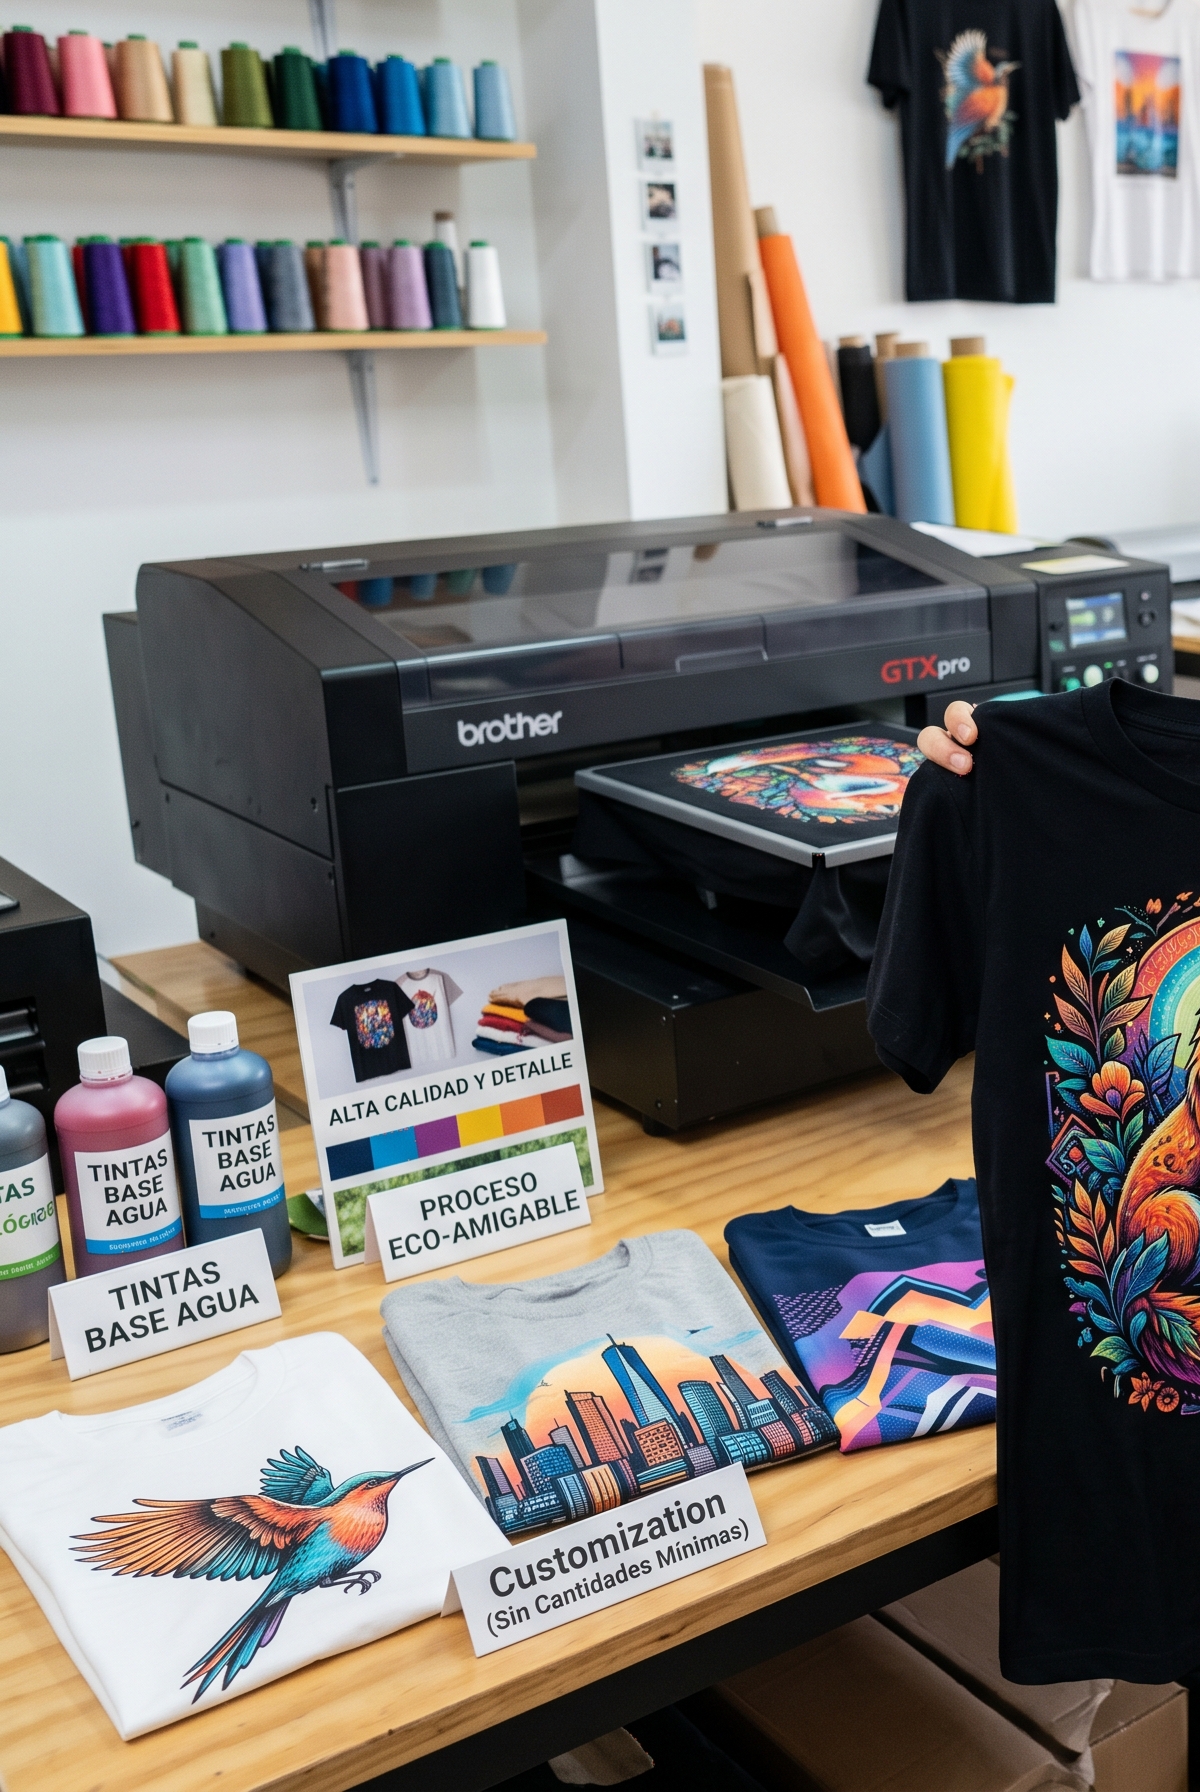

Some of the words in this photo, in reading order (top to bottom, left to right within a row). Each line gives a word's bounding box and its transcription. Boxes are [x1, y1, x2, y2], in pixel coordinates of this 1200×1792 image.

[881, 653, 971, 684] GTXpro
[457, 710, 563, 747] brother
[329, 1100, 380, 1126] ALTA
[384, 1078, 469, 1112] CALIDAD
[473, 1073, 486, 1090] Y
[491, 1052, 573, 1087] DETALLE
[202, 1114, 275, 1148] TINTAS
[87, 1148, 168, 1182] TINTAS
[217, 1139, 272, 1169] BASE
[104, 1174, 164, 1204] BASE
[219, 1162, 276, 1192] AGUA
[106, 1197, 168, 1226] AGUA
[420, 1172, 538, 1221] PROCESO
[388, 1189, 581, 1260] ECO-AMIGABLE
[108, 1261, 221, 1311] TINTAS
[84, 1308, 169, 1354] BASE
[177, 1283, 260, 1327] AGUA
[489, 1494, 727, 1598] Customization
[487, 1605, 531, 1638] (Sin
[535, 1559, 652, 1615] Cantidades
[655, 1518, 750, 1569] Mínimas)
